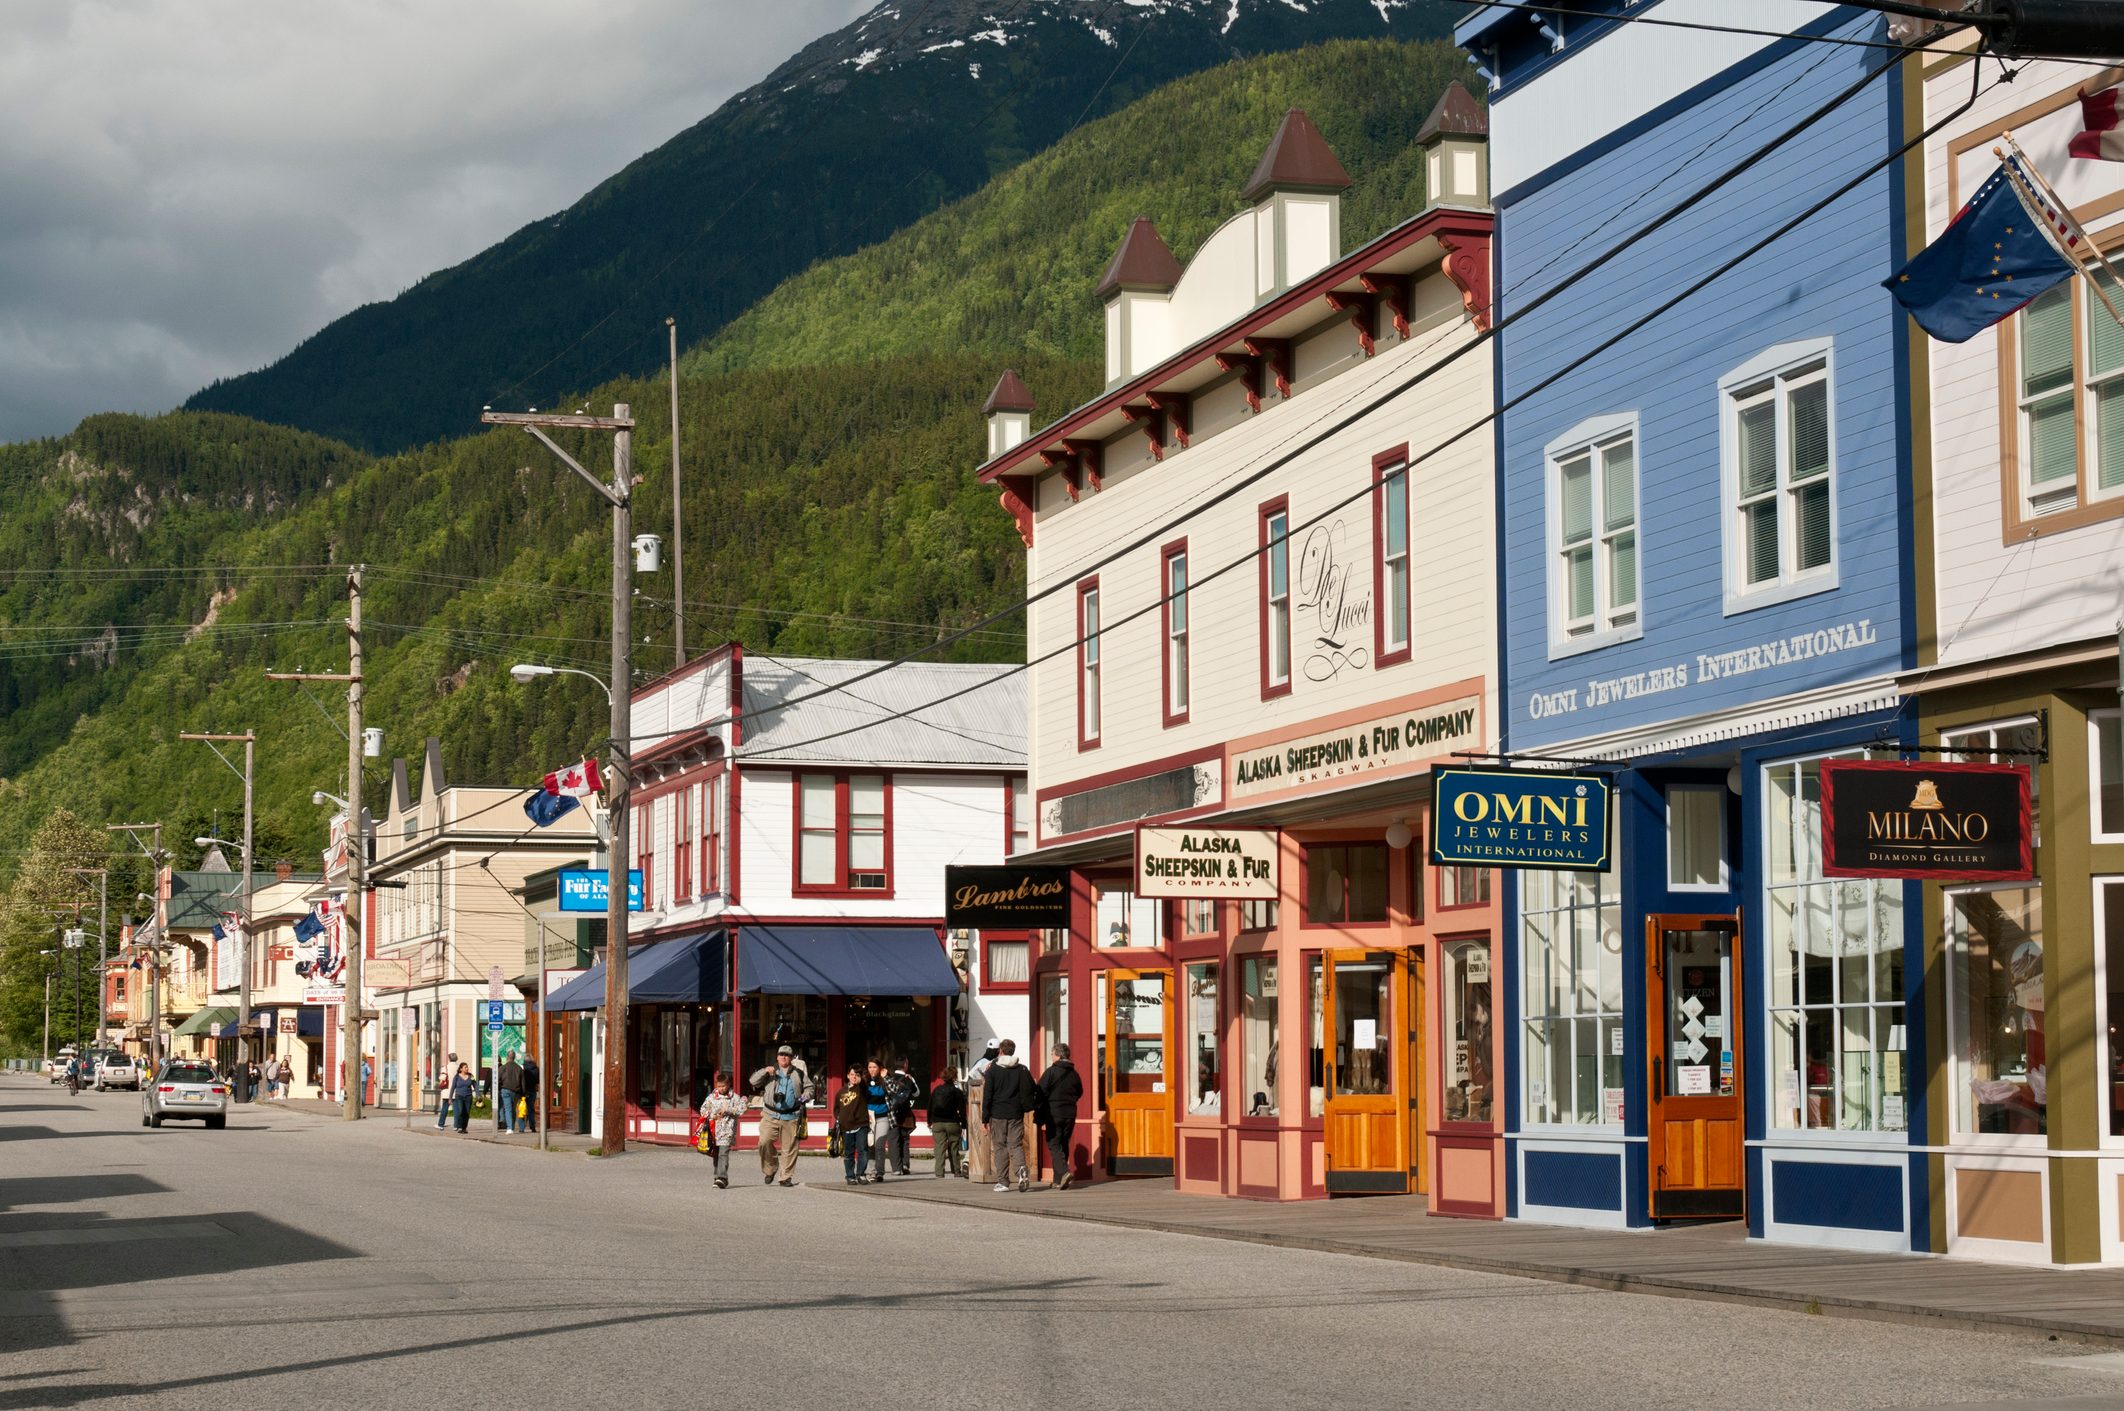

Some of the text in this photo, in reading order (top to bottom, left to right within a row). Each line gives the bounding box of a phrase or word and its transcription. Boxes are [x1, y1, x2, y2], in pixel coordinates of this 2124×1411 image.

[1529, 619, 1876, 720] OMNI JEWELERS INTERNATIONAL
[1237, 708, 1475, 785] ALASKA SHEEPSKIN & FUR COMPANY
[1299, 758, 1389, 783] SKAGWAY
[1454, 826, 1589, 843] JEWELERS
[1867, 811, 1988, 842] MILANO
[1180, 835, 1242, 853] ALASKA
[1457, 844, 1585, 859] INTERNATIONAL
[1145, 854, 1270, 879] SHEEPSKIN & FUR
[1869, 852, 1986, 863] DIAMOND GALLERY
[953, 877, 1063, 910] Lambros
